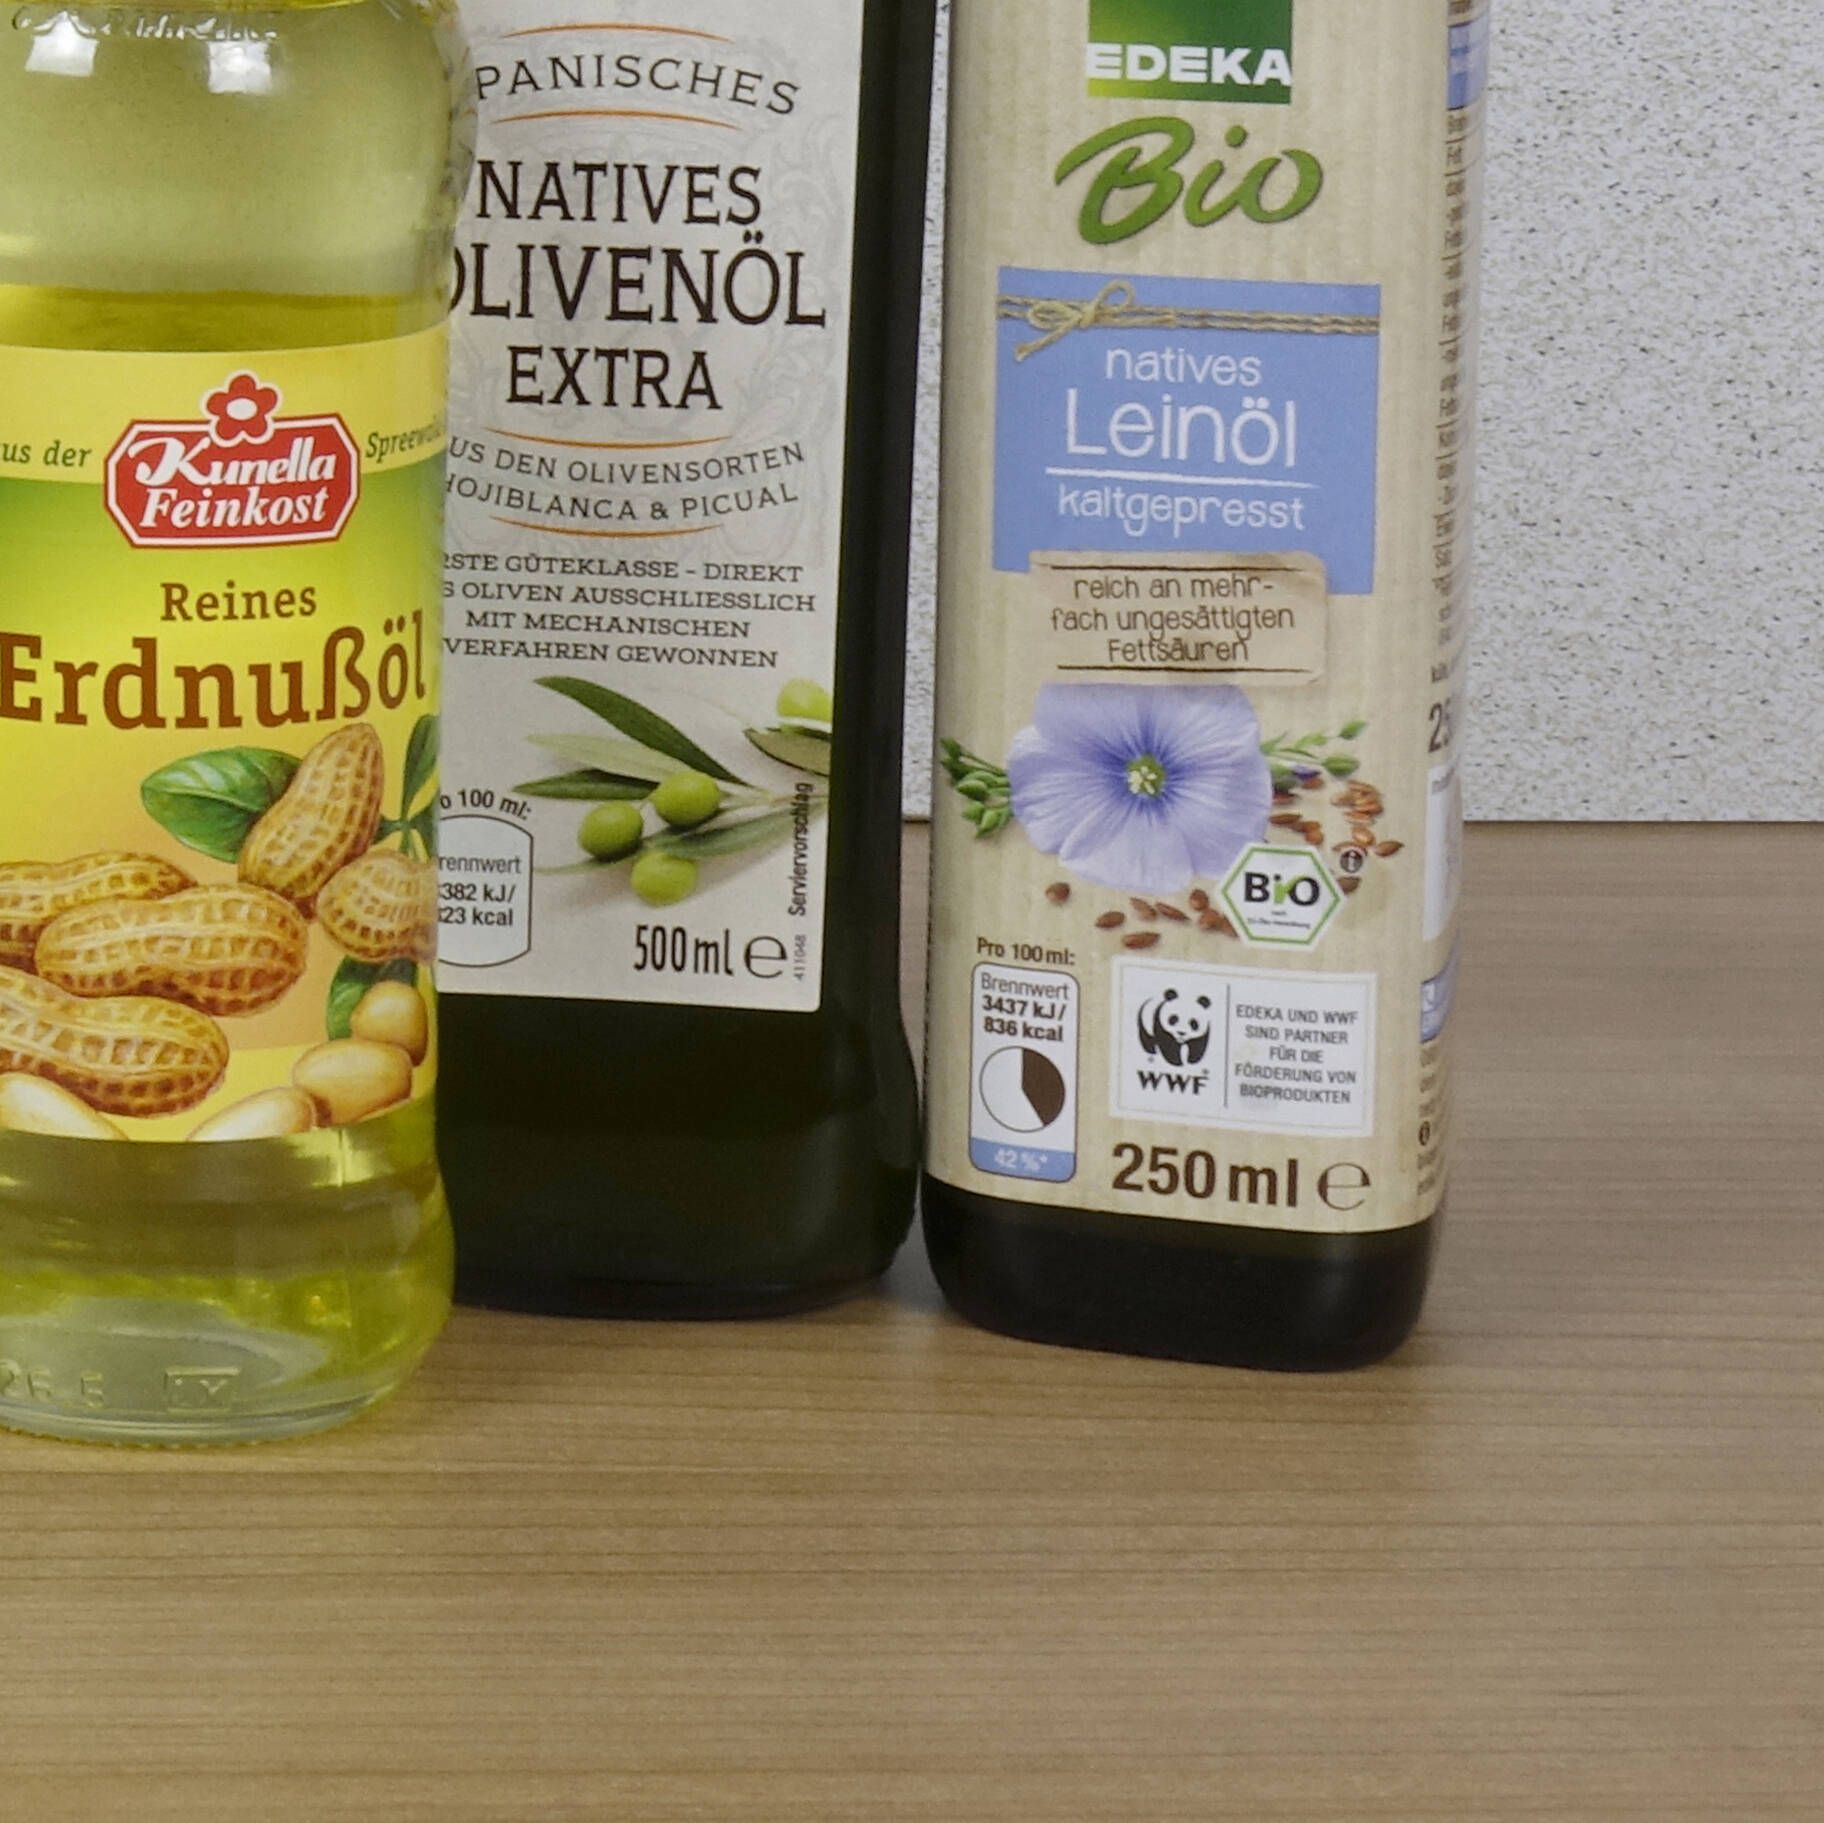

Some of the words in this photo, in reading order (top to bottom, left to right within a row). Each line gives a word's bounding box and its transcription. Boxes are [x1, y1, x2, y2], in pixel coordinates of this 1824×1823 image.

[1085, 42, 1292, 86] EDEKA
[475, 54, 803, 115] PANISCHES
[477, 160, 762, 226] NATIVES
[1055, 116, 1324, 245] Bio
[506, 345, 723, 411] EXTRA
[1106, 347, 1262, 387] natives
[1066, 386, 1297, 467] Leinöl
[43, 439, 92, 469] der
[128, 437, 336, 488] Kunella
[449, 435, 486, 464] US
[494, 448, 558, 478] DEN
[568, 442, 804, 484] OLIVENSORTEN
[140, 487, 329, 529] Feinkost
[649, 500, 669, 519] &
[682, 481, 799, 517] PICUAL
[1059, 483, 1305, 538] kaltgepresst
[443, 552, 498, 572] RSTE
[505, 553, 679, 578] GÜTEKLASSE
[703, 562, 803, 583] DIREKT
[160, 582, 318, 622] Reines
[461, 581, 563, 602] OLIVEN
[570, 586, 817, 613] AUSSCHLIESSLICH
[1074, 575, 1140, 600] reich
[1149, 577, 1182, 599] an
[1191, 572, 1274, 599] mehr-
[466, 609, 517, 628] MIT
[523, 612, 751, 639] MECHANISCHEN
[1051, 607, 1108, 632] fach
[1116, 605, 1295, 644] ungesättigten
[444, 636, 611, 662] VERFAHREN
[617, 643, 779, 669] GEWONNEN
[1108, 636, 1249, 663] Fettsäuren
[457, 788, 495, 809] 100
[499, 796, 532, 821] ml:
[439, 855, 522, 875] rennwert
[788, 781, 814, 917] Serviervorschlag
[472, 907, 514, 927] kcal
[633, 924, 687, 974] 500
[692, 927, 735, 977] ml
[976, 936, 1004, 958] Pro
[980, 971, 1070, 1001] Brennwert
[982, 993, 1028, 1017] 3437
[1235, 1004, 1283, 1023] EDEKA
[1288, 1008, 1319, 1024] UND
[1323, 1010, 1359, 1026] WWF
[983, 1015, 1018, 1036] 836
[1022, 1020, 1064, 1042] kcal
[1244, 1025, 1280, 1043] SIND
[1284, 1027, 1349, 1046] PARTNER
[1269, 1044, 1296, 1062] FÜR
[1301, 1048, 1324, 1064] DIE
[1137, 1070, 1209, 1096] WWF
[1234, 1061, 1323, 1084] FÖRDERUNG
[1327, 1069, 1357, 1084] VON
[1239, 1082, 1351, 1105] BIOPRODUKTEN
[1112, 1141, 1216, 1201] 250
[1228, 1157, 1299, 1209] ml
